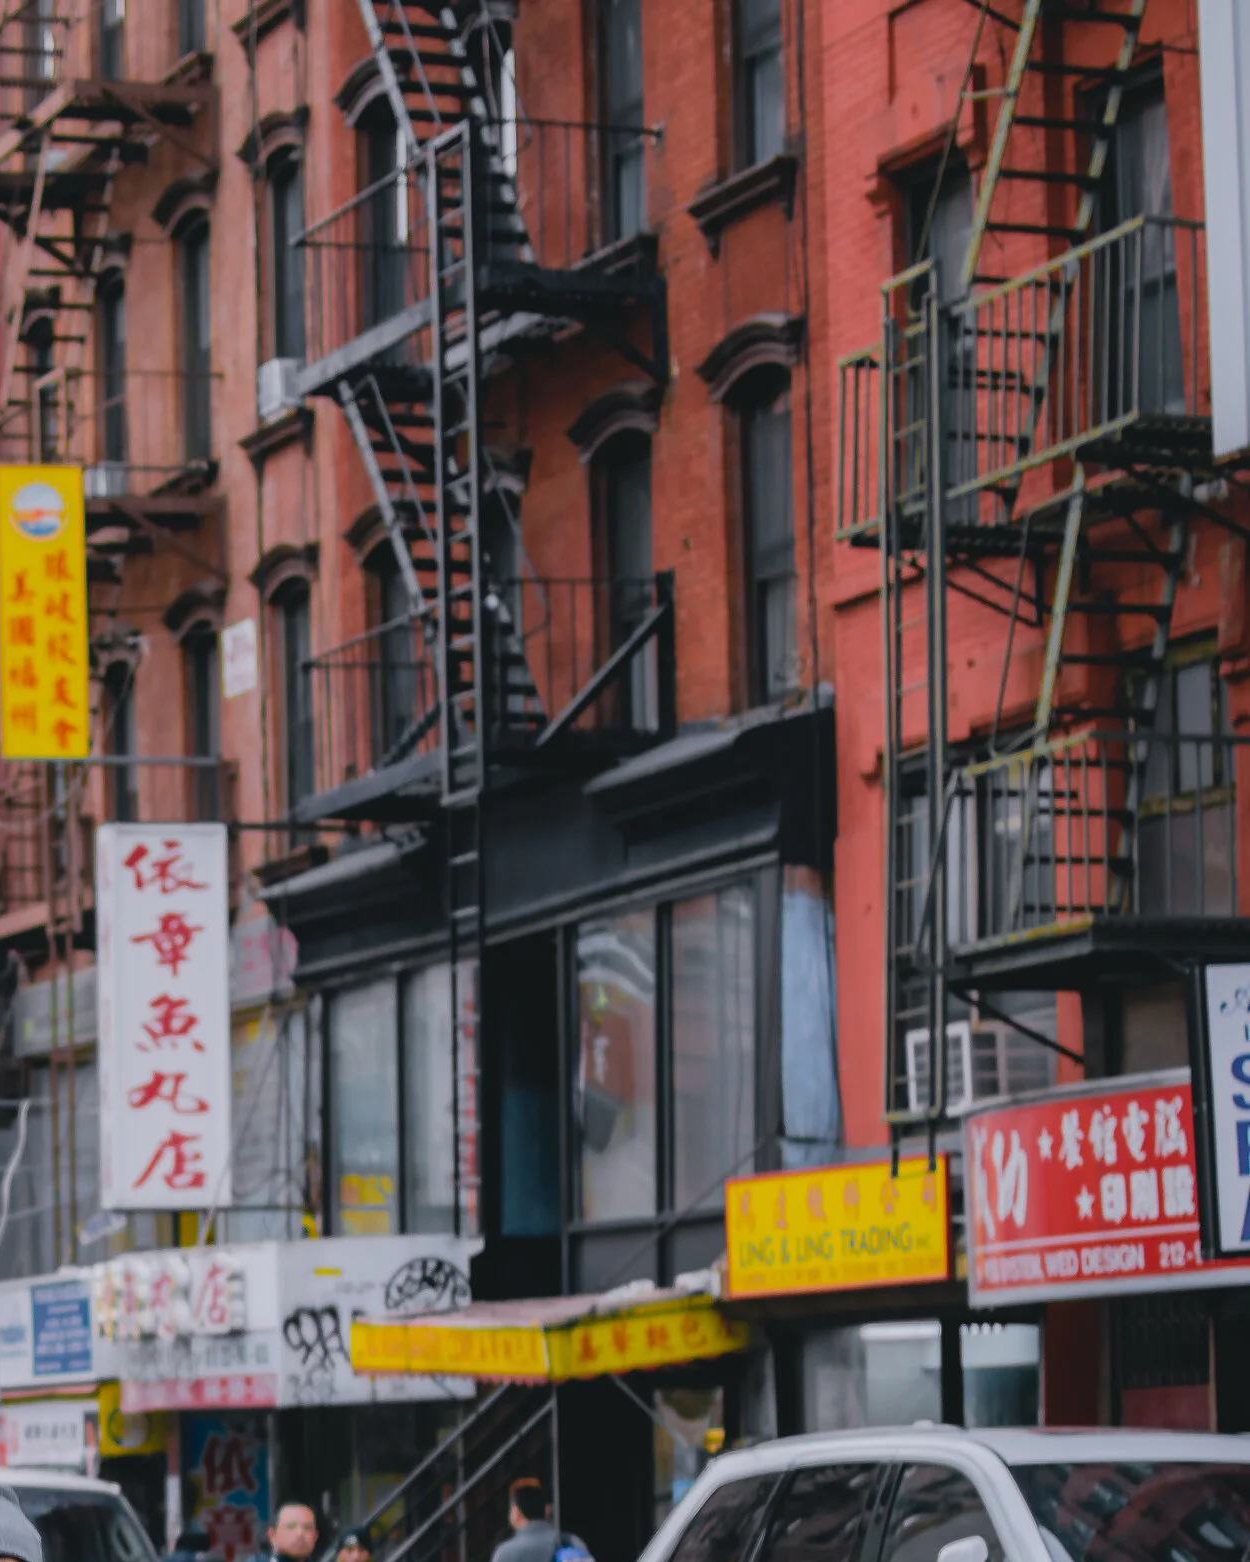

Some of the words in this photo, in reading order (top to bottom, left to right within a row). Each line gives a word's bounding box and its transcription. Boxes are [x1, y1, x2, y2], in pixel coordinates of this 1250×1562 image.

[123, 839, 210, 1190] 依章魚丸店
[739, 1237, 775, 1267] LING
[797, 1232, 834, 1262] LING
[841, 1222, 913, 1256] TRADING
[1081, 1243, 1145, 1274] DESIGN
